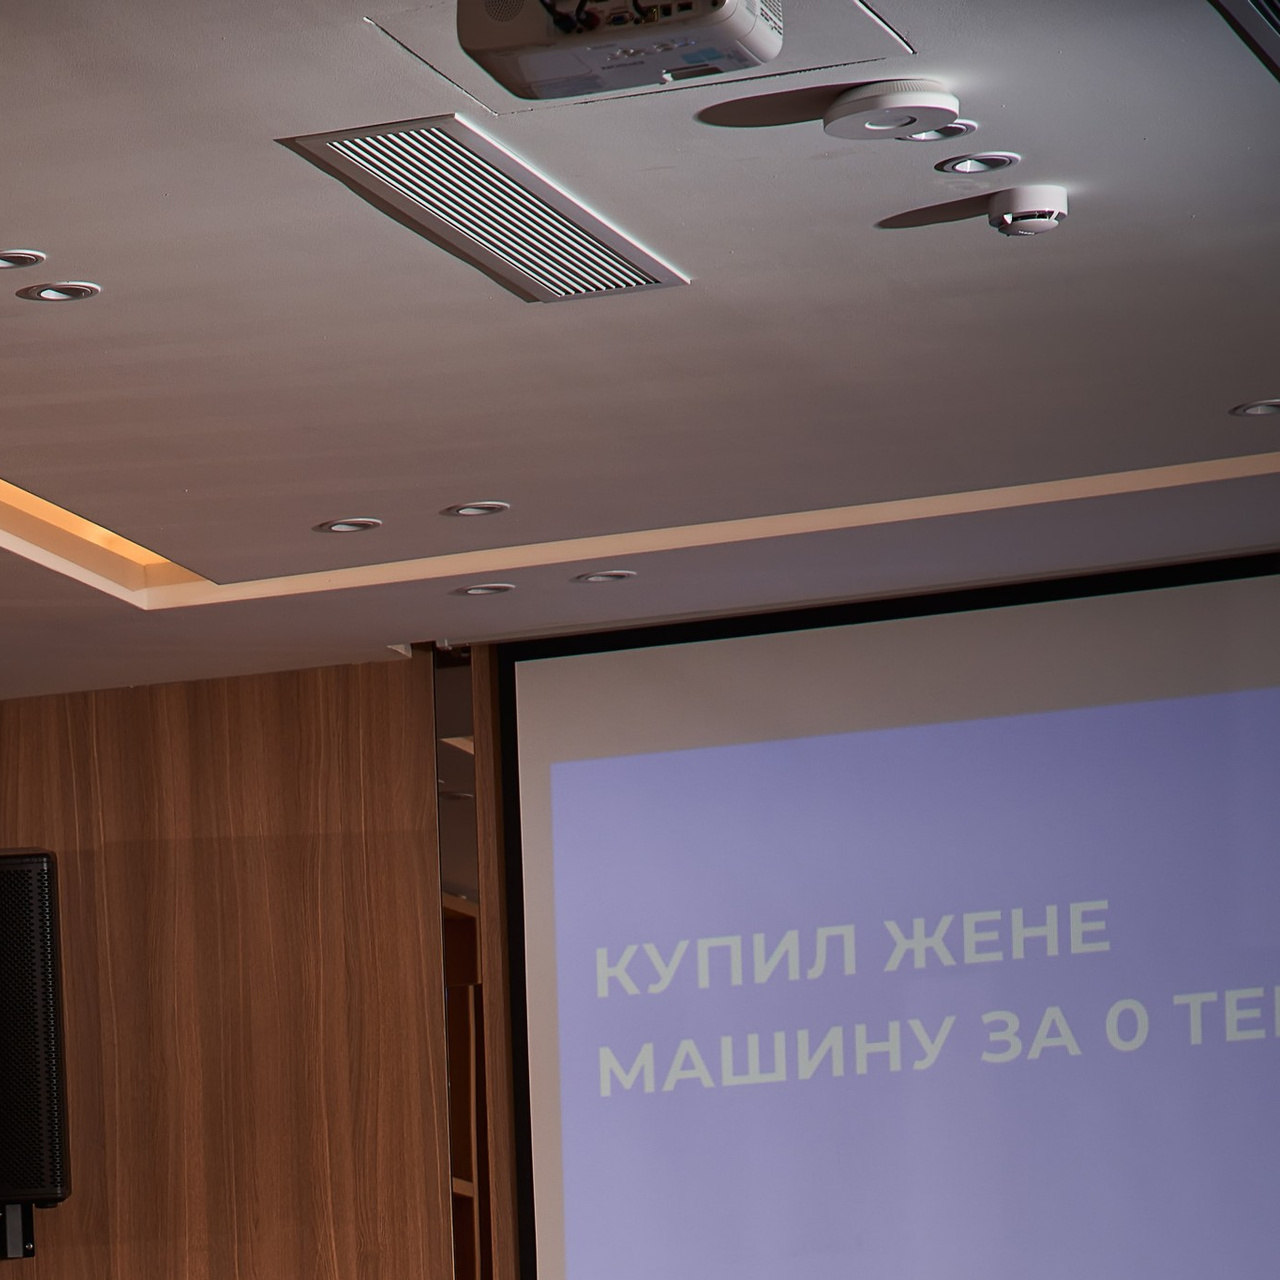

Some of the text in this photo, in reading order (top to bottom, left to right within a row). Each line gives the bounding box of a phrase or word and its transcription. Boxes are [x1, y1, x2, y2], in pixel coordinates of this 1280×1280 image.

[595, 899, 1111, 998] КУПИЛ ЖЕНЕ
[598, 1016, 956, 1097] МАШИНУ
[980, 1004, 1082, 1063] ЗА
[1172, 985, 1280, 1045] ТЕ
